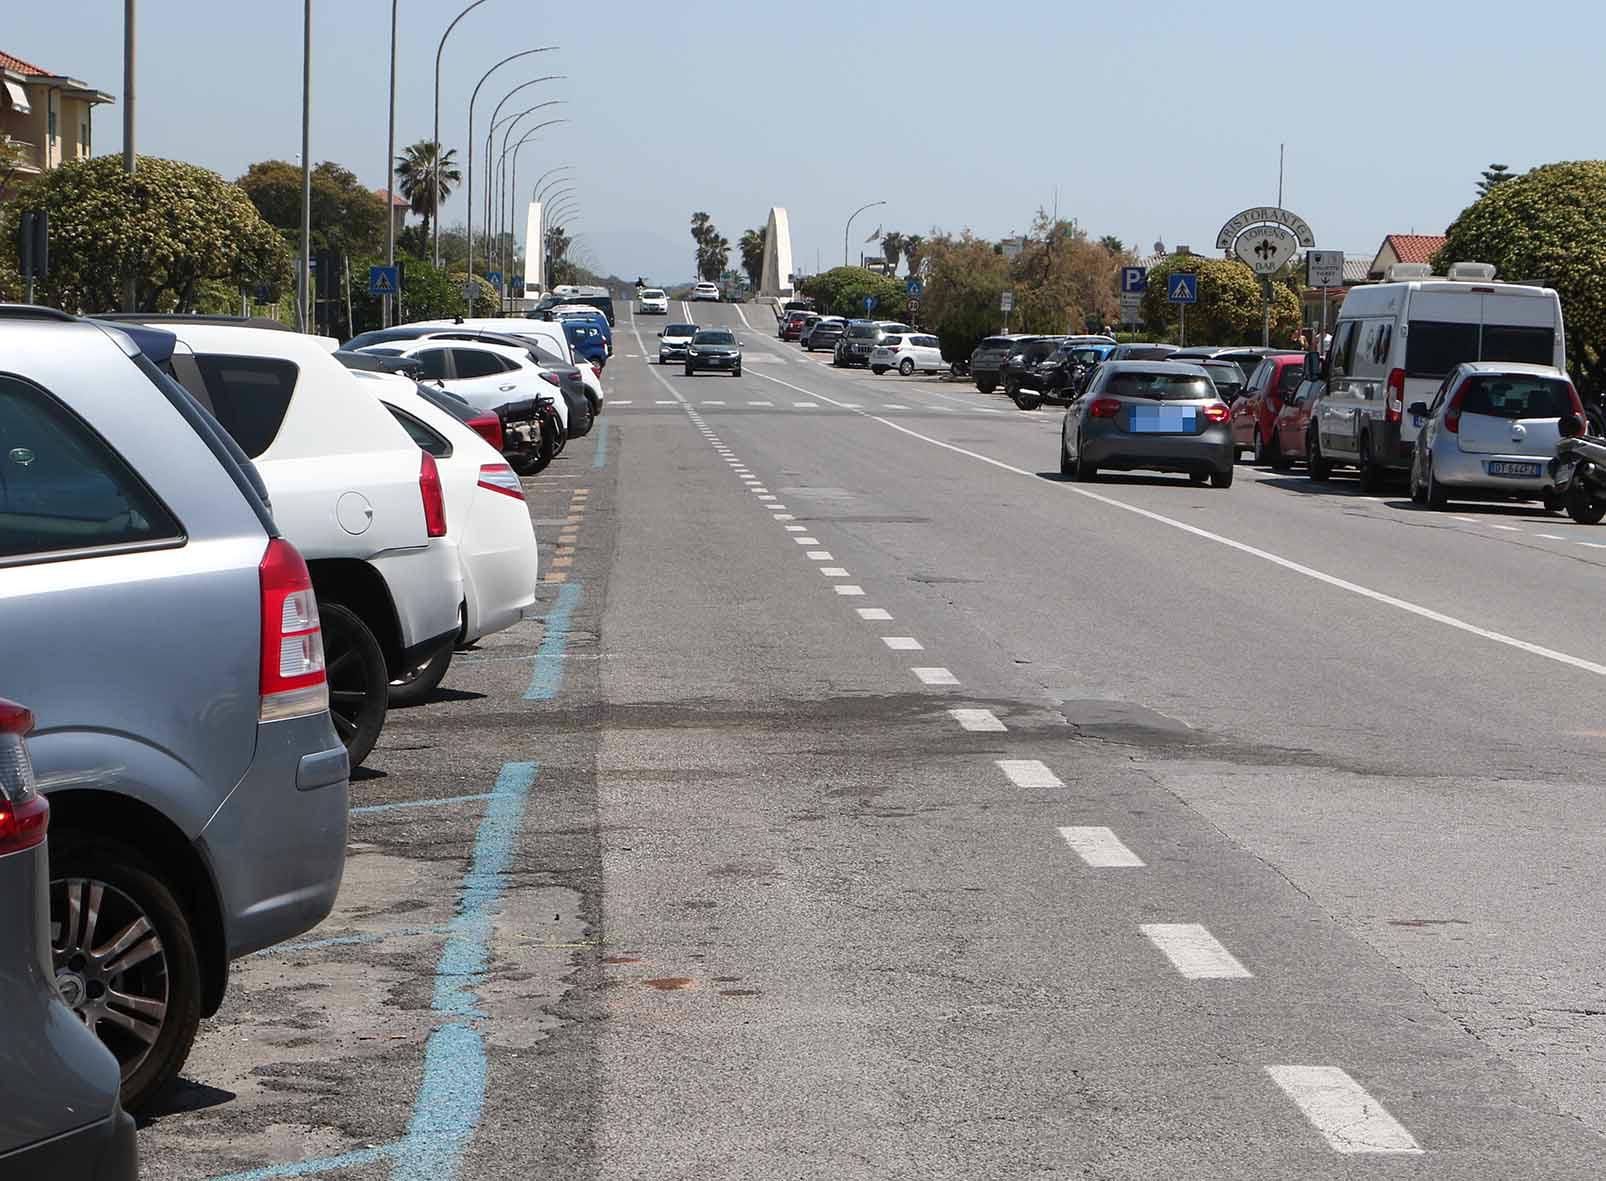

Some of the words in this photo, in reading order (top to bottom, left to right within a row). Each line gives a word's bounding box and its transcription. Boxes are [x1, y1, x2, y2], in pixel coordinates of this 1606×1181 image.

[1223, 209, 1307, 238] RISTORANTE
[1255, 262, 1276, 271] BAR
[1126, 269, 1141, 290] P
